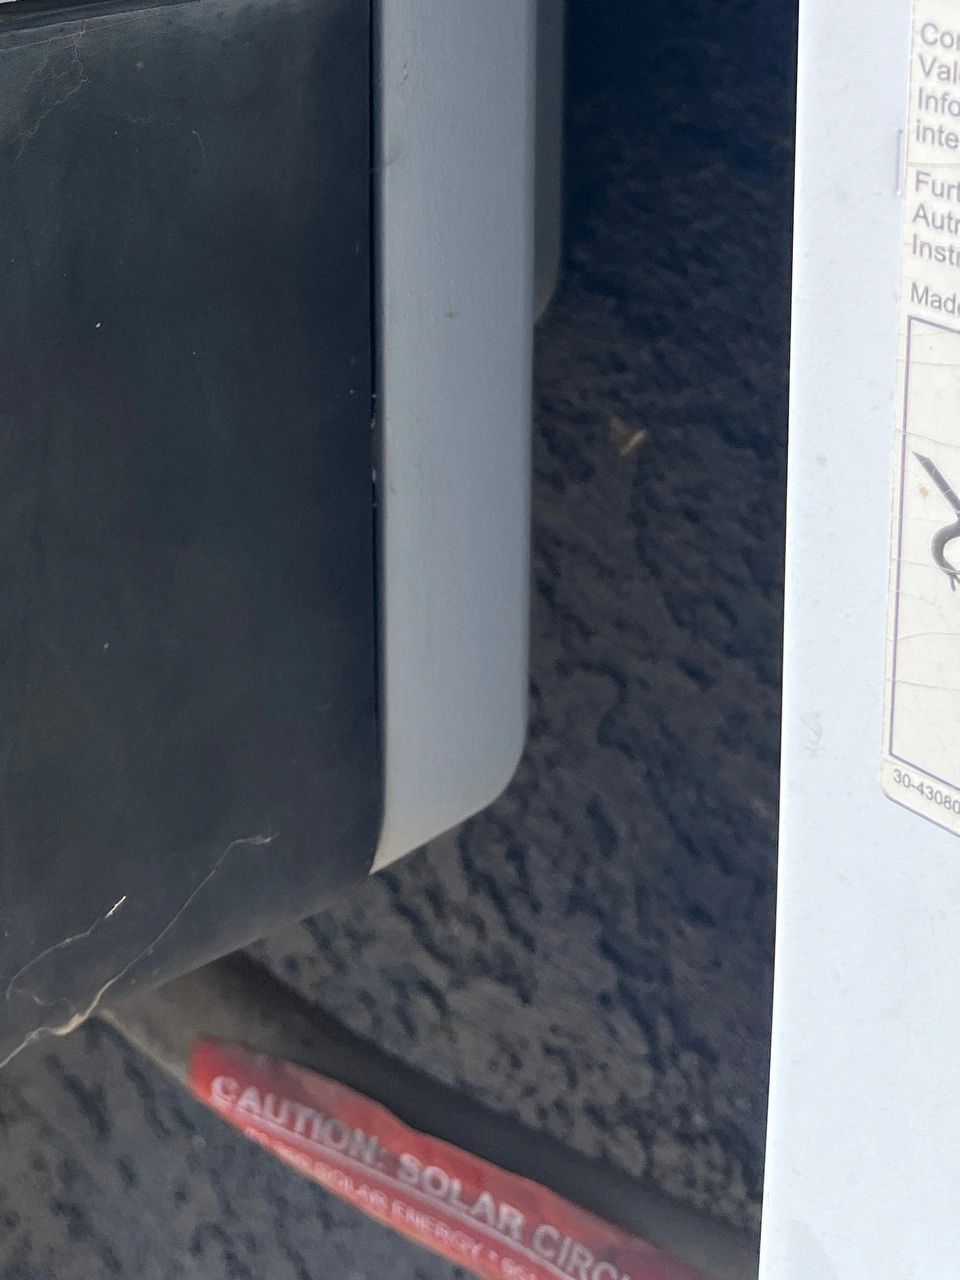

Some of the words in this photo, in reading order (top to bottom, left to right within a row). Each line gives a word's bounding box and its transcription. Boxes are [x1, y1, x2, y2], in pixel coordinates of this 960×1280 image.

[921, 22, 960, 51] Co
[918, 53, 960, 83] Val
[911, 282, 960, 317] Mad
[211, 1076, 386, 1170] CAUTION:
[397, 1152, 525, 1244] SOLAR
[532, 1224, 631, 1280] CIRC
